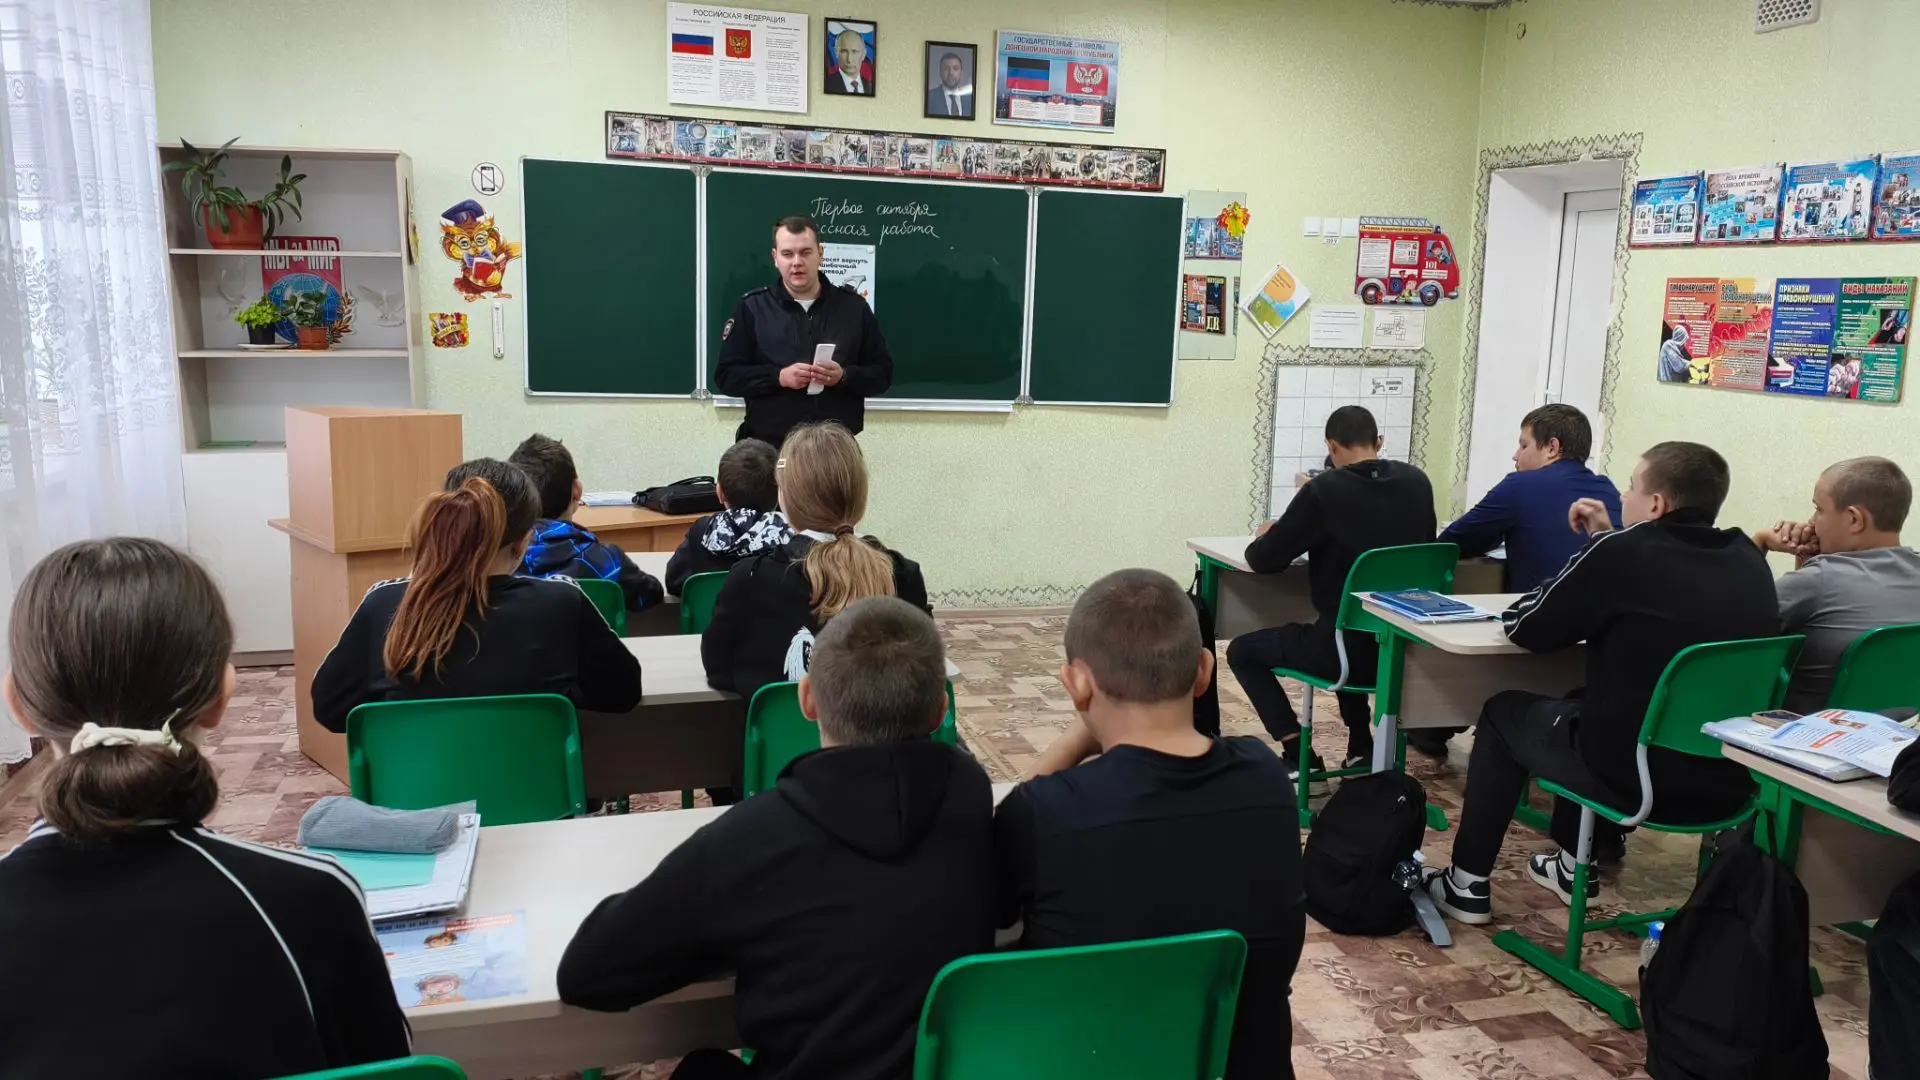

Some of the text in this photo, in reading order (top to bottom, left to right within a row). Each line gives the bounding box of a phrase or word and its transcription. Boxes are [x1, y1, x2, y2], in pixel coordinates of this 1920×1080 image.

[693, 8, 786, 24] РОССИЙСКАЯ ФЕДЕРАЦИЯ
[1013, 35, 1073, 48] ГОСУДАРСТВЕННЫЕ
[1038, 46, 1073, 57] НАРОДНОЙ
[811, 197, 938, 224] Первое октября
[817, 220, 940, 246] ссная работа
[264, 239, 290, 270] МЫ
[306, 239, 338, 270] МИР
[1425, 261, 1437, 269] 101
[1669, 282, 1717, 293] ПРАВОНАРУШЕНИЕ
[1779, 283, 1811, 294] ПРИЗНАКИ
[1842, 281, 1908, 295] ВИДЫ НАКАЗАНИЙ
[1777, 292, 1836, 304] ПРАВОНАРУШЕНИЙ
